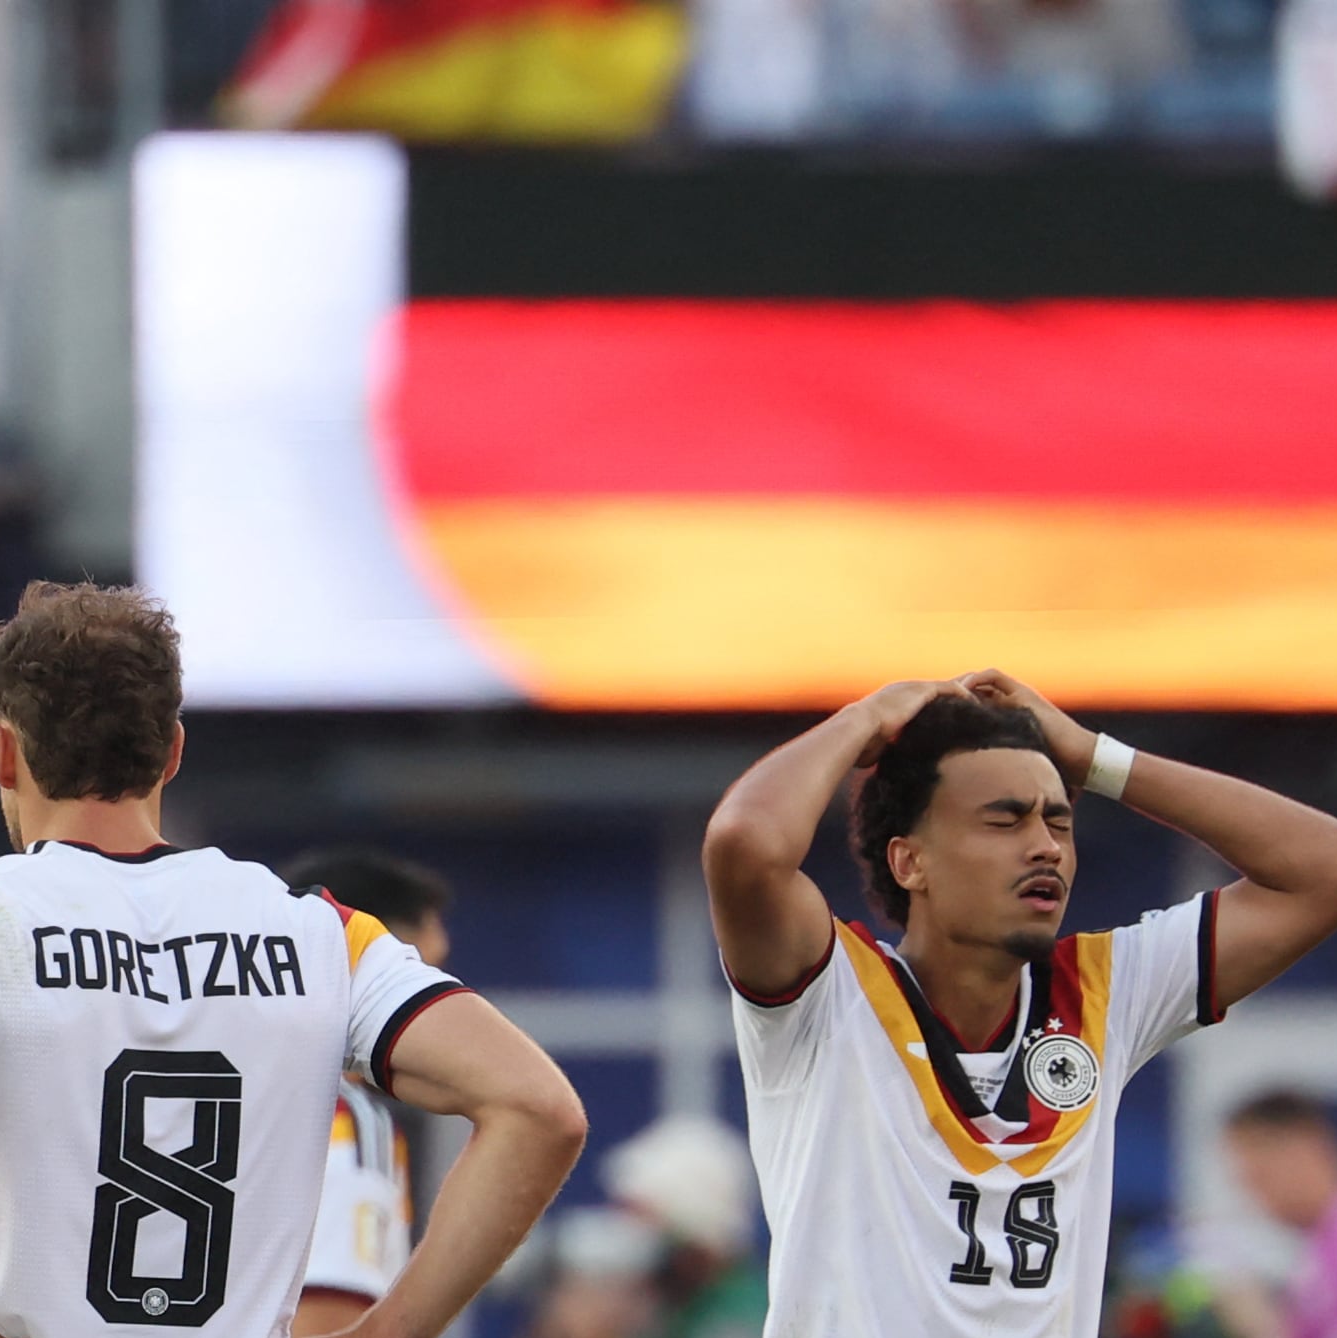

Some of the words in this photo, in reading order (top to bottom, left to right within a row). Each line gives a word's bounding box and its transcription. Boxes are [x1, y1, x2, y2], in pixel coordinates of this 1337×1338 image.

[32, 925, 306, 1005] GORETZKA
[85, 1048, 243, 1328] 8
[948, 1179, 1060, 1289] 18
